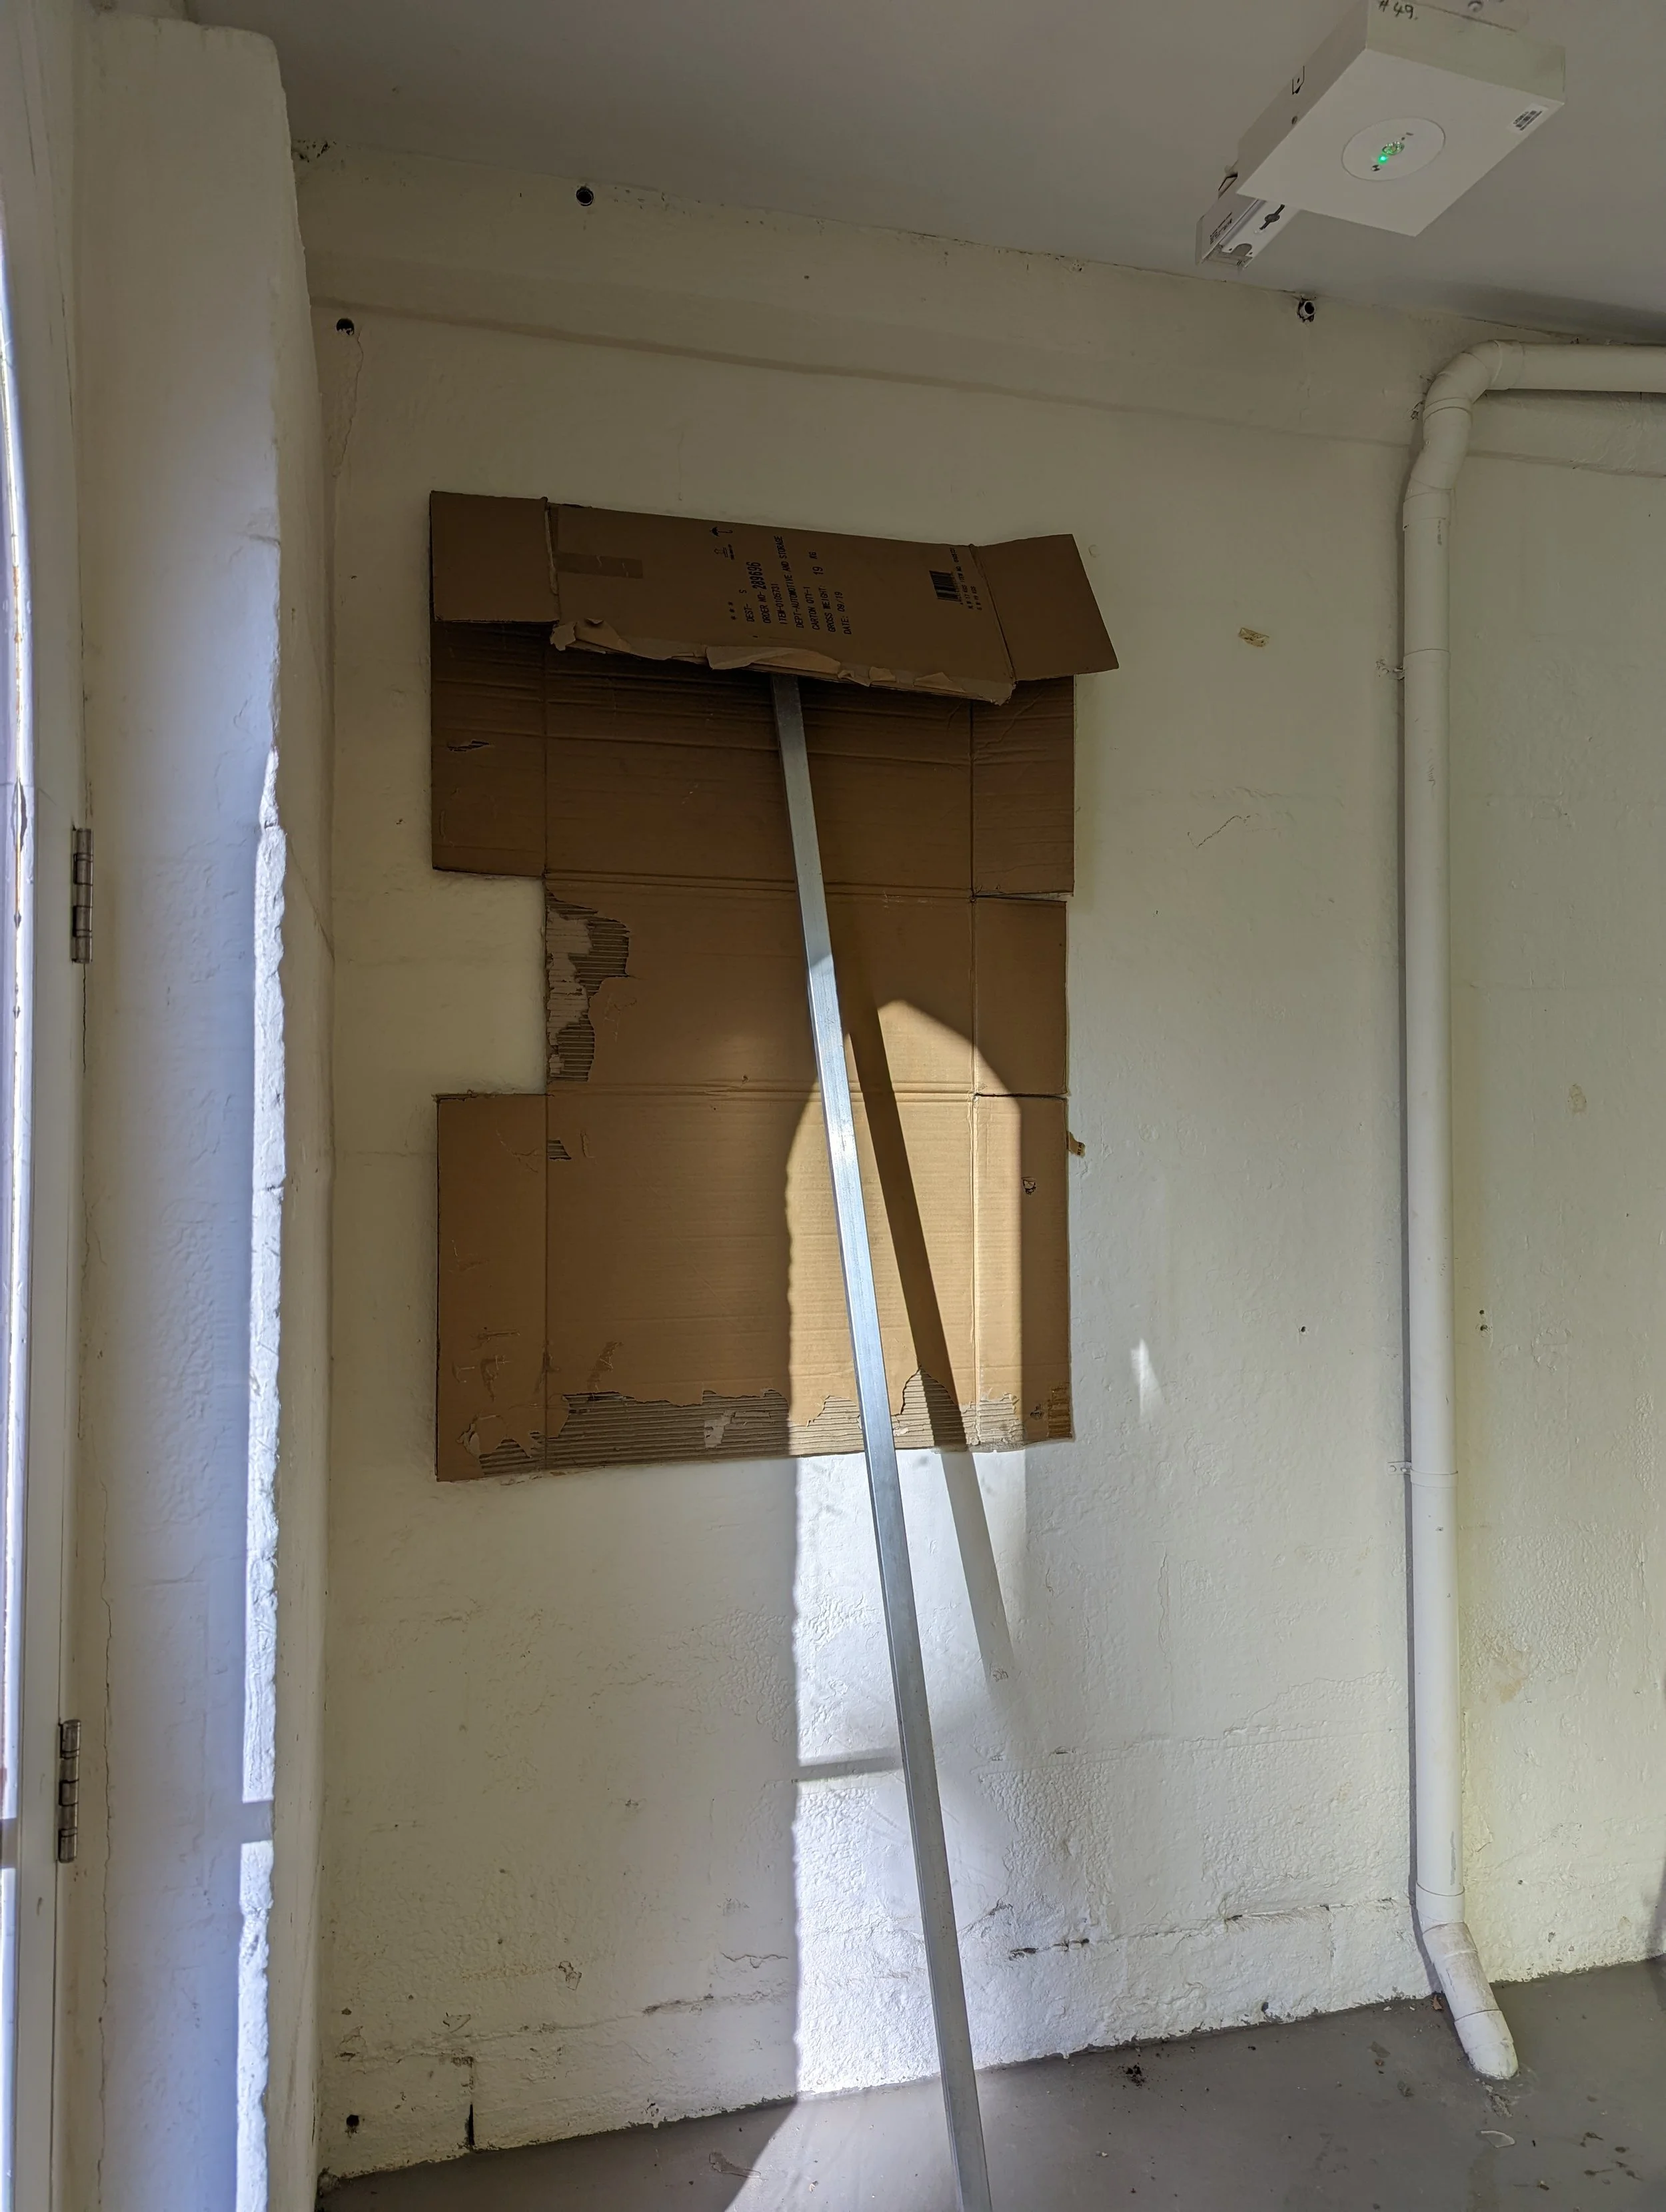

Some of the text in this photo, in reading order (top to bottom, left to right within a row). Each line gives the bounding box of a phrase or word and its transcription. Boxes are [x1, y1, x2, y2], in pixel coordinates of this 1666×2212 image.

[746, 562, 767, 590] 289696
[812, 566, 824, 576] 19
[774, 536, 804, 628] DEPT-AUTOMOTIVE AND STORAGE
[744, 604, 754, 622] DEST-
[760, 605, 771, 623] ORDER
[808, 606, 820, 630] CARTON
[824, 613, 836, 632] GROSS
[834, 592, 852, 634] DATE: 09/19
